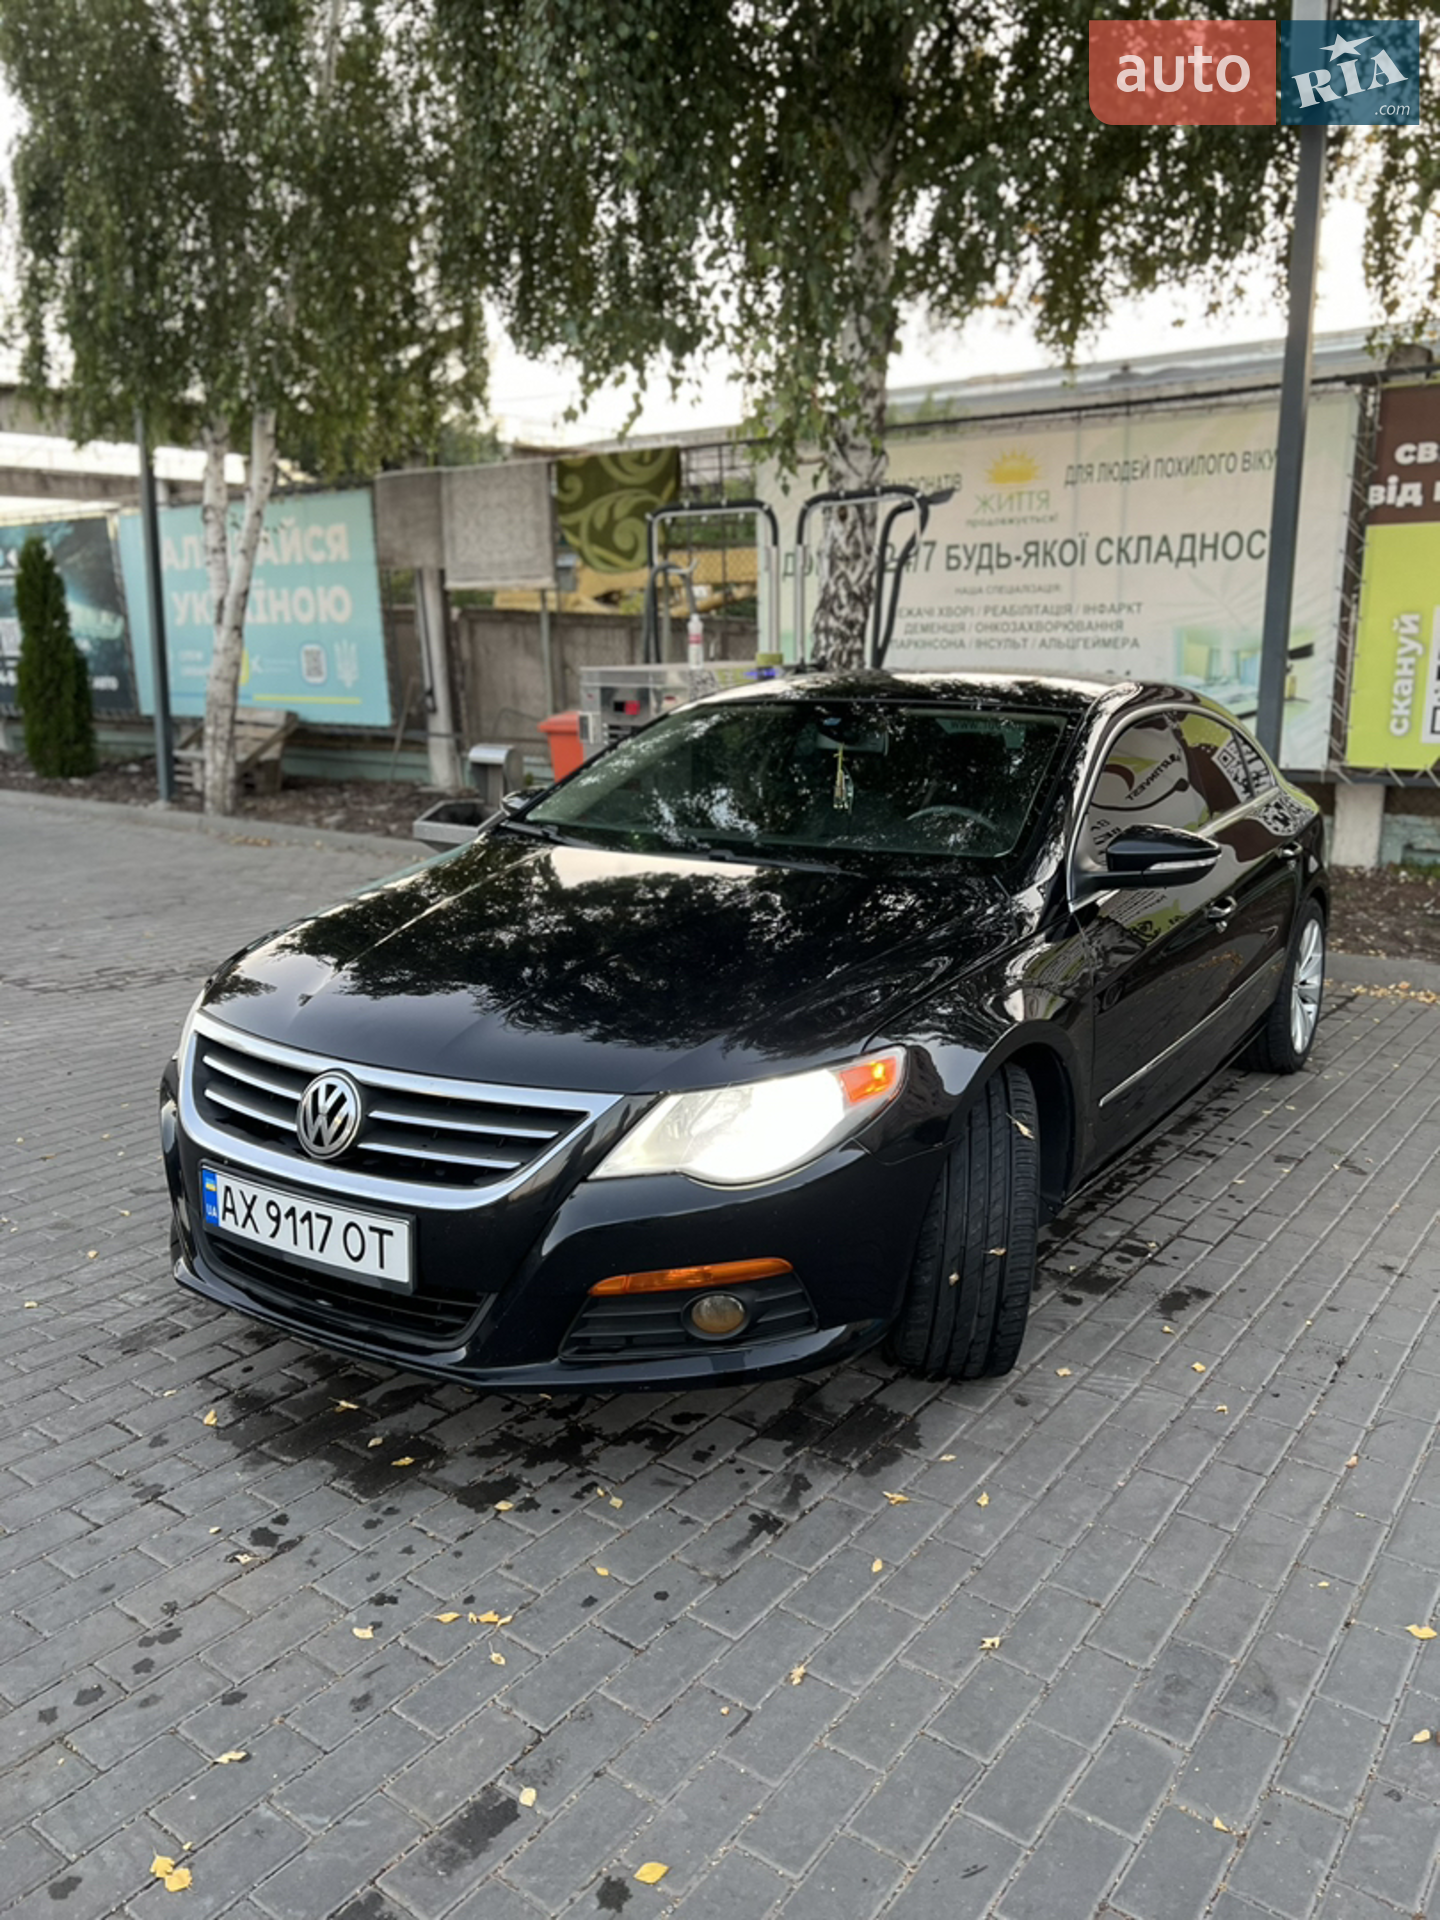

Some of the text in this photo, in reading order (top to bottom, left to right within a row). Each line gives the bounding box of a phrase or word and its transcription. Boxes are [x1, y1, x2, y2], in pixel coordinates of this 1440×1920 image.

[1394, 441, 1440, 465] св
[1064, 463, 1095, 489] ДЛЯ
[1097, 455, 1151, 485] ЛЮДЕЙ
[1154, 452, 1239, 479] ПОХИЛОГО
[973, 489, 1051, 514] ЖИТТЯ
[1367, 474, 1423, 508] від
[945, 532, 1088, 575] БУДЬ-ЯКОЇ
[1095, 529, 1271, 570] СКЛАДНОС
[172, 578, 353, 627] УКЇНОЮ
[896, 605, 935, 619] ЕЖАЧІ
[938, 605, 975, 618] ХВОРІ
[984, 602, 1073, 618] РЕАБІЛІТАЦІЯ
[1083, 601, 1142, 616] ІНФАРКТ
[975, 636, 1028, 651] ІНСУЛЬТ
[1038, 634, 1141, 650] АЛЬЦГЕЙМЕРА
[1389, 612, 1425, 737] скануй
[205, 1203, 218, 1219] UA
[221, 1184, 395, 1270] AX 9117 OT
